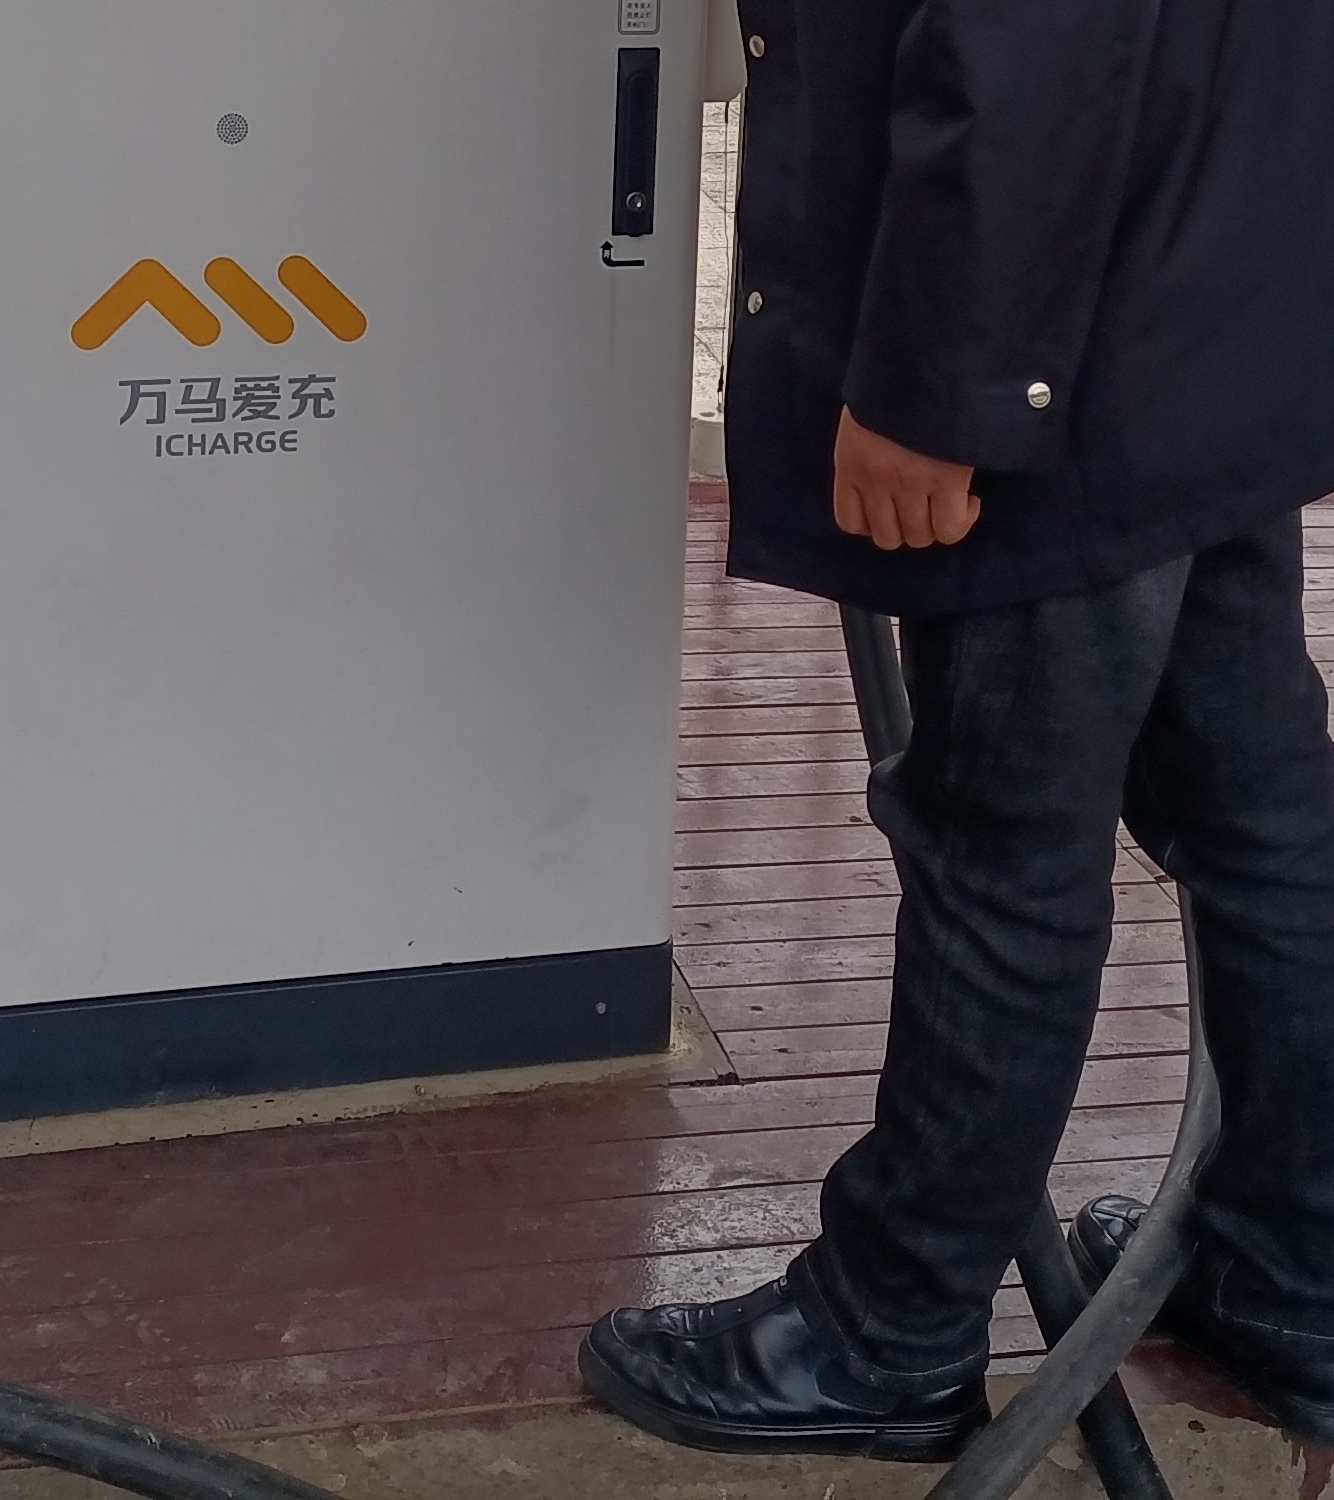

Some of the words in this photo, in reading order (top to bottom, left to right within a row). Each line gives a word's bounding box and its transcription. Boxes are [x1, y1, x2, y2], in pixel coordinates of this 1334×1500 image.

[118, 374, 336, 425] 万马爱充
[155, 430, 298, 457] ICHARGE
